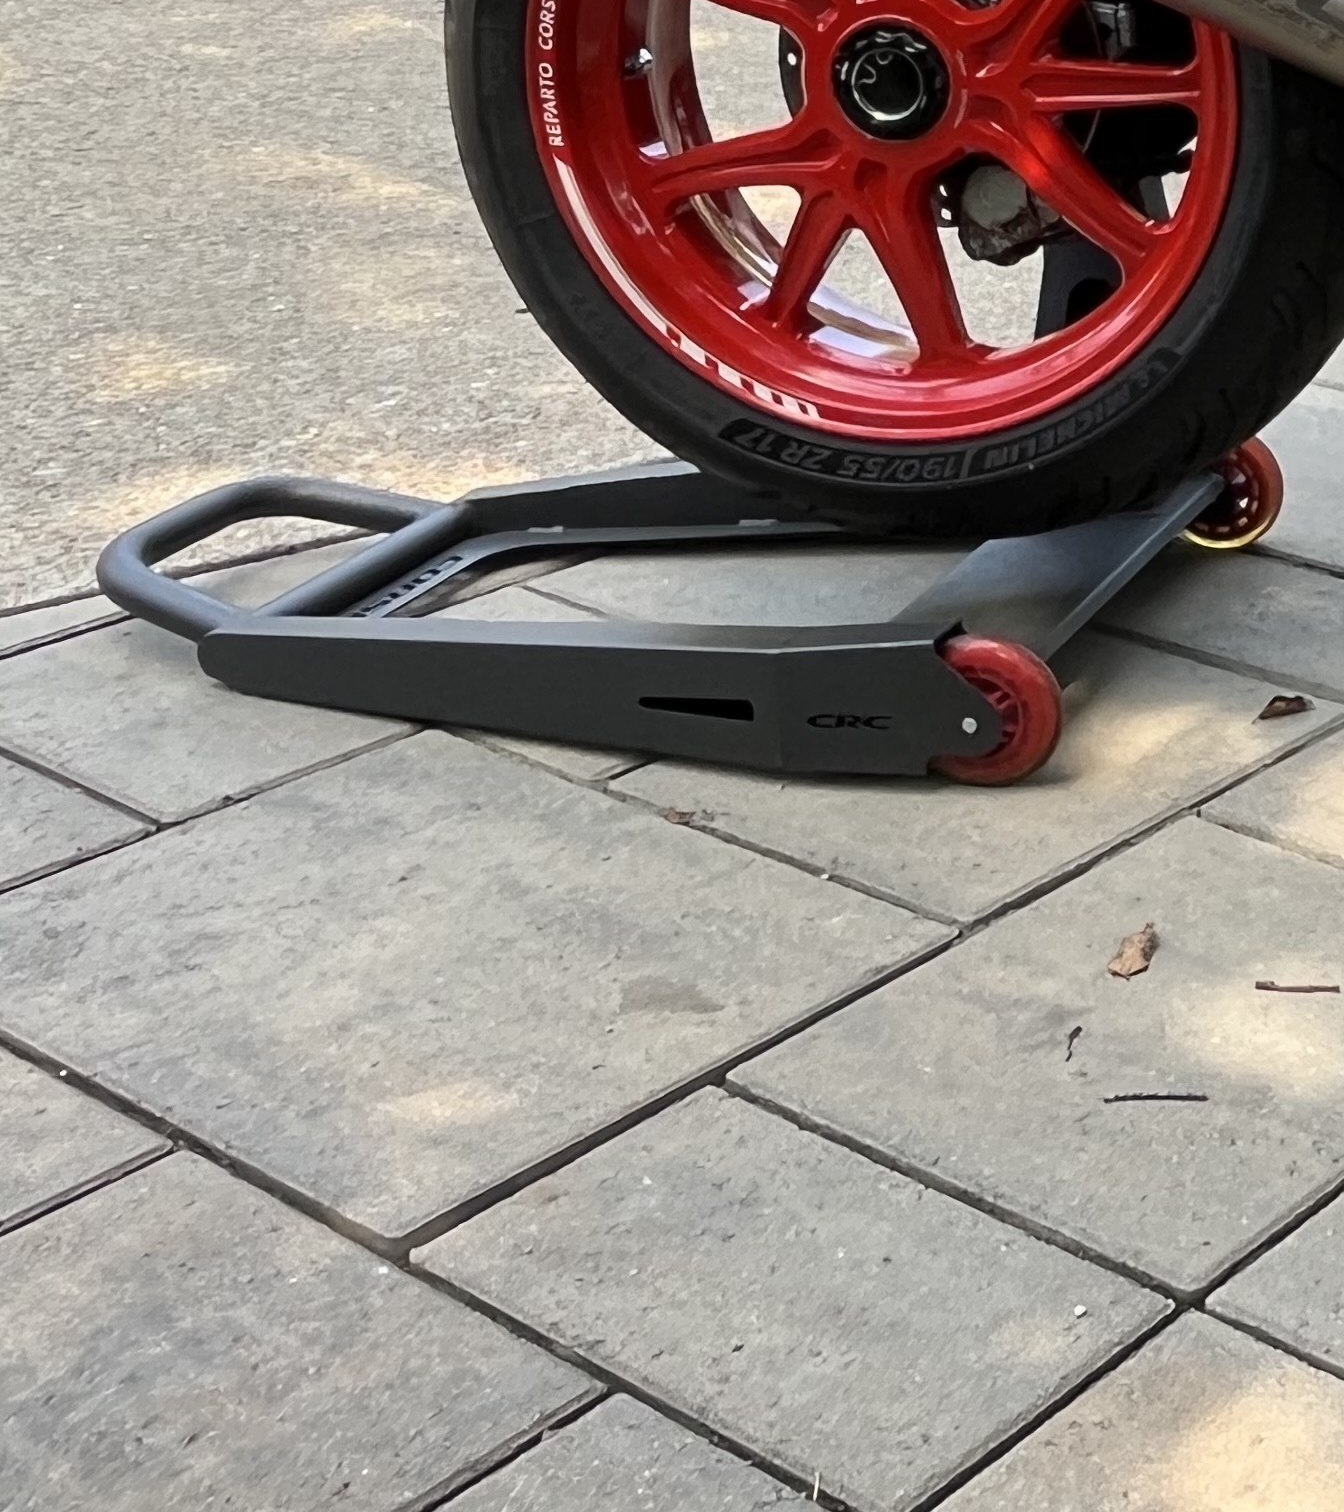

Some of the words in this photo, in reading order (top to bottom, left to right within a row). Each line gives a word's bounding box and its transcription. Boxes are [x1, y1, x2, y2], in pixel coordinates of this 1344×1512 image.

[539, 62, 565, 148] REPARTO
[734, 427, 777, 456] 17
[983, 386, 1130, 470] MICHELIN
[781, 438, 832, 473] ZR
[835, 454, 959, 481] 190/55
[806, 714, 894, 731] CRC
